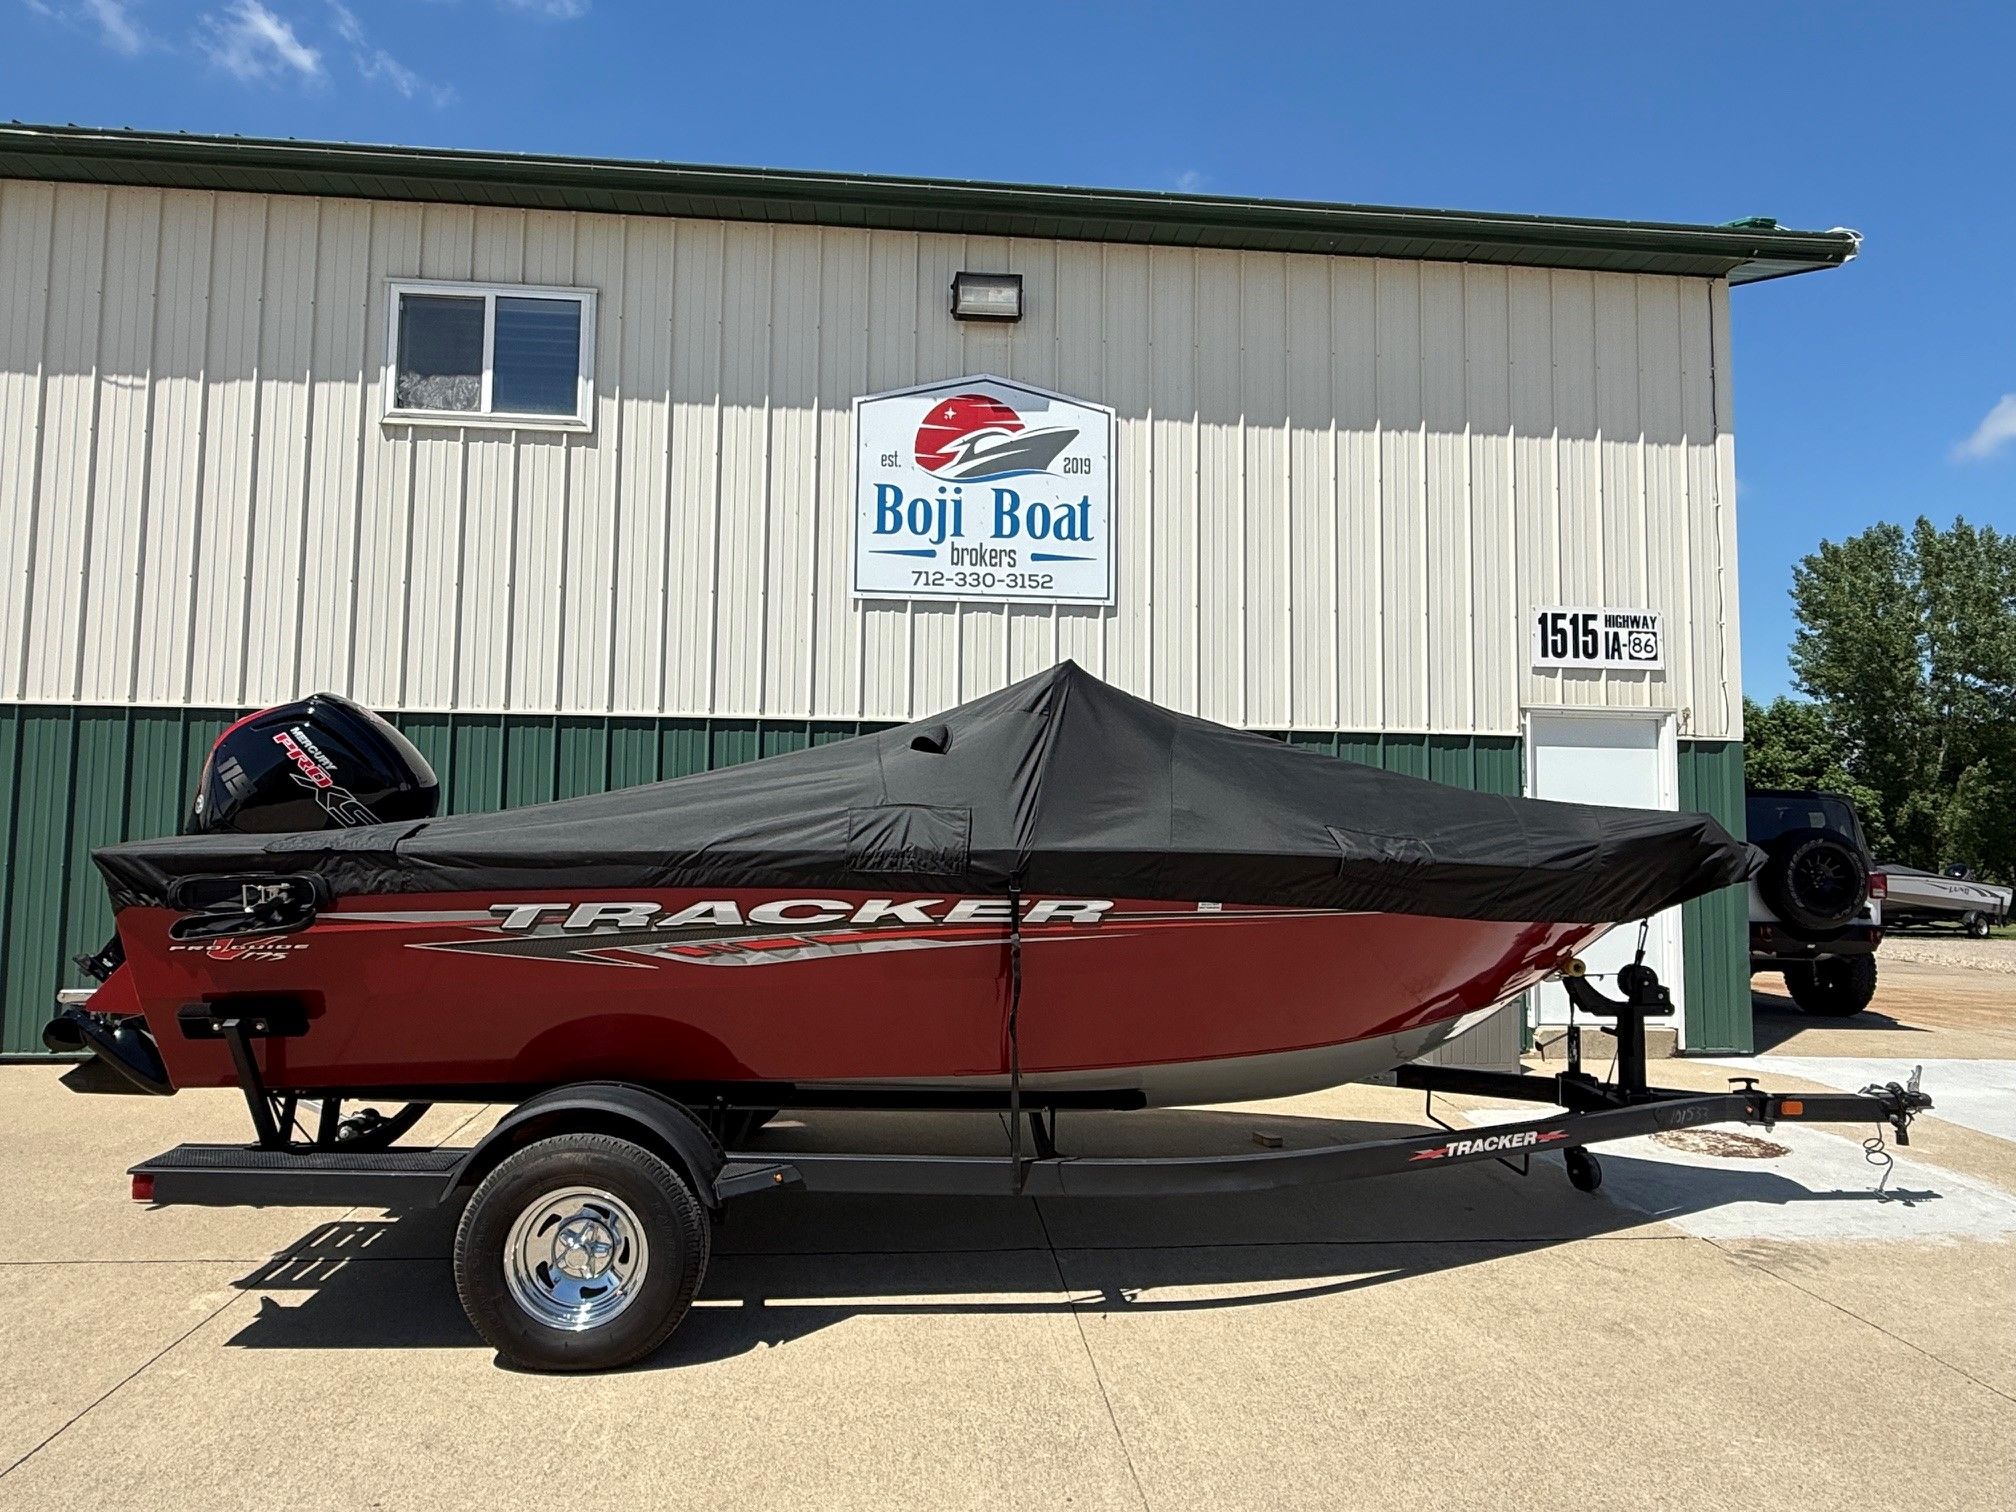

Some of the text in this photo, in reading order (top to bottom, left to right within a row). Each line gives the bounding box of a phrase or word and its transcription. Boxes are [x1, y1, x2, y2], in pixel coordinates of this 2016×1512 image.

[881, 451, 901, 468] est.
[1064, 457, 1091, 475] 2019
[873, 483, 1094, 545] Boji Boat
[951, 541, 1016, 567] brokers
[912, 571, 1053, 589] 712-330-3152
[1604, 614, 1657, 629] HIGHWAY
[1538, 612, 1599, 660] 1515
[272, 732, 333, 788] PRO
[290, 726, 338, 770] MERCURY
[489, 899, 1114, 929] TRACKER
[1446, 1131, 1538, 1158] TRACKER
